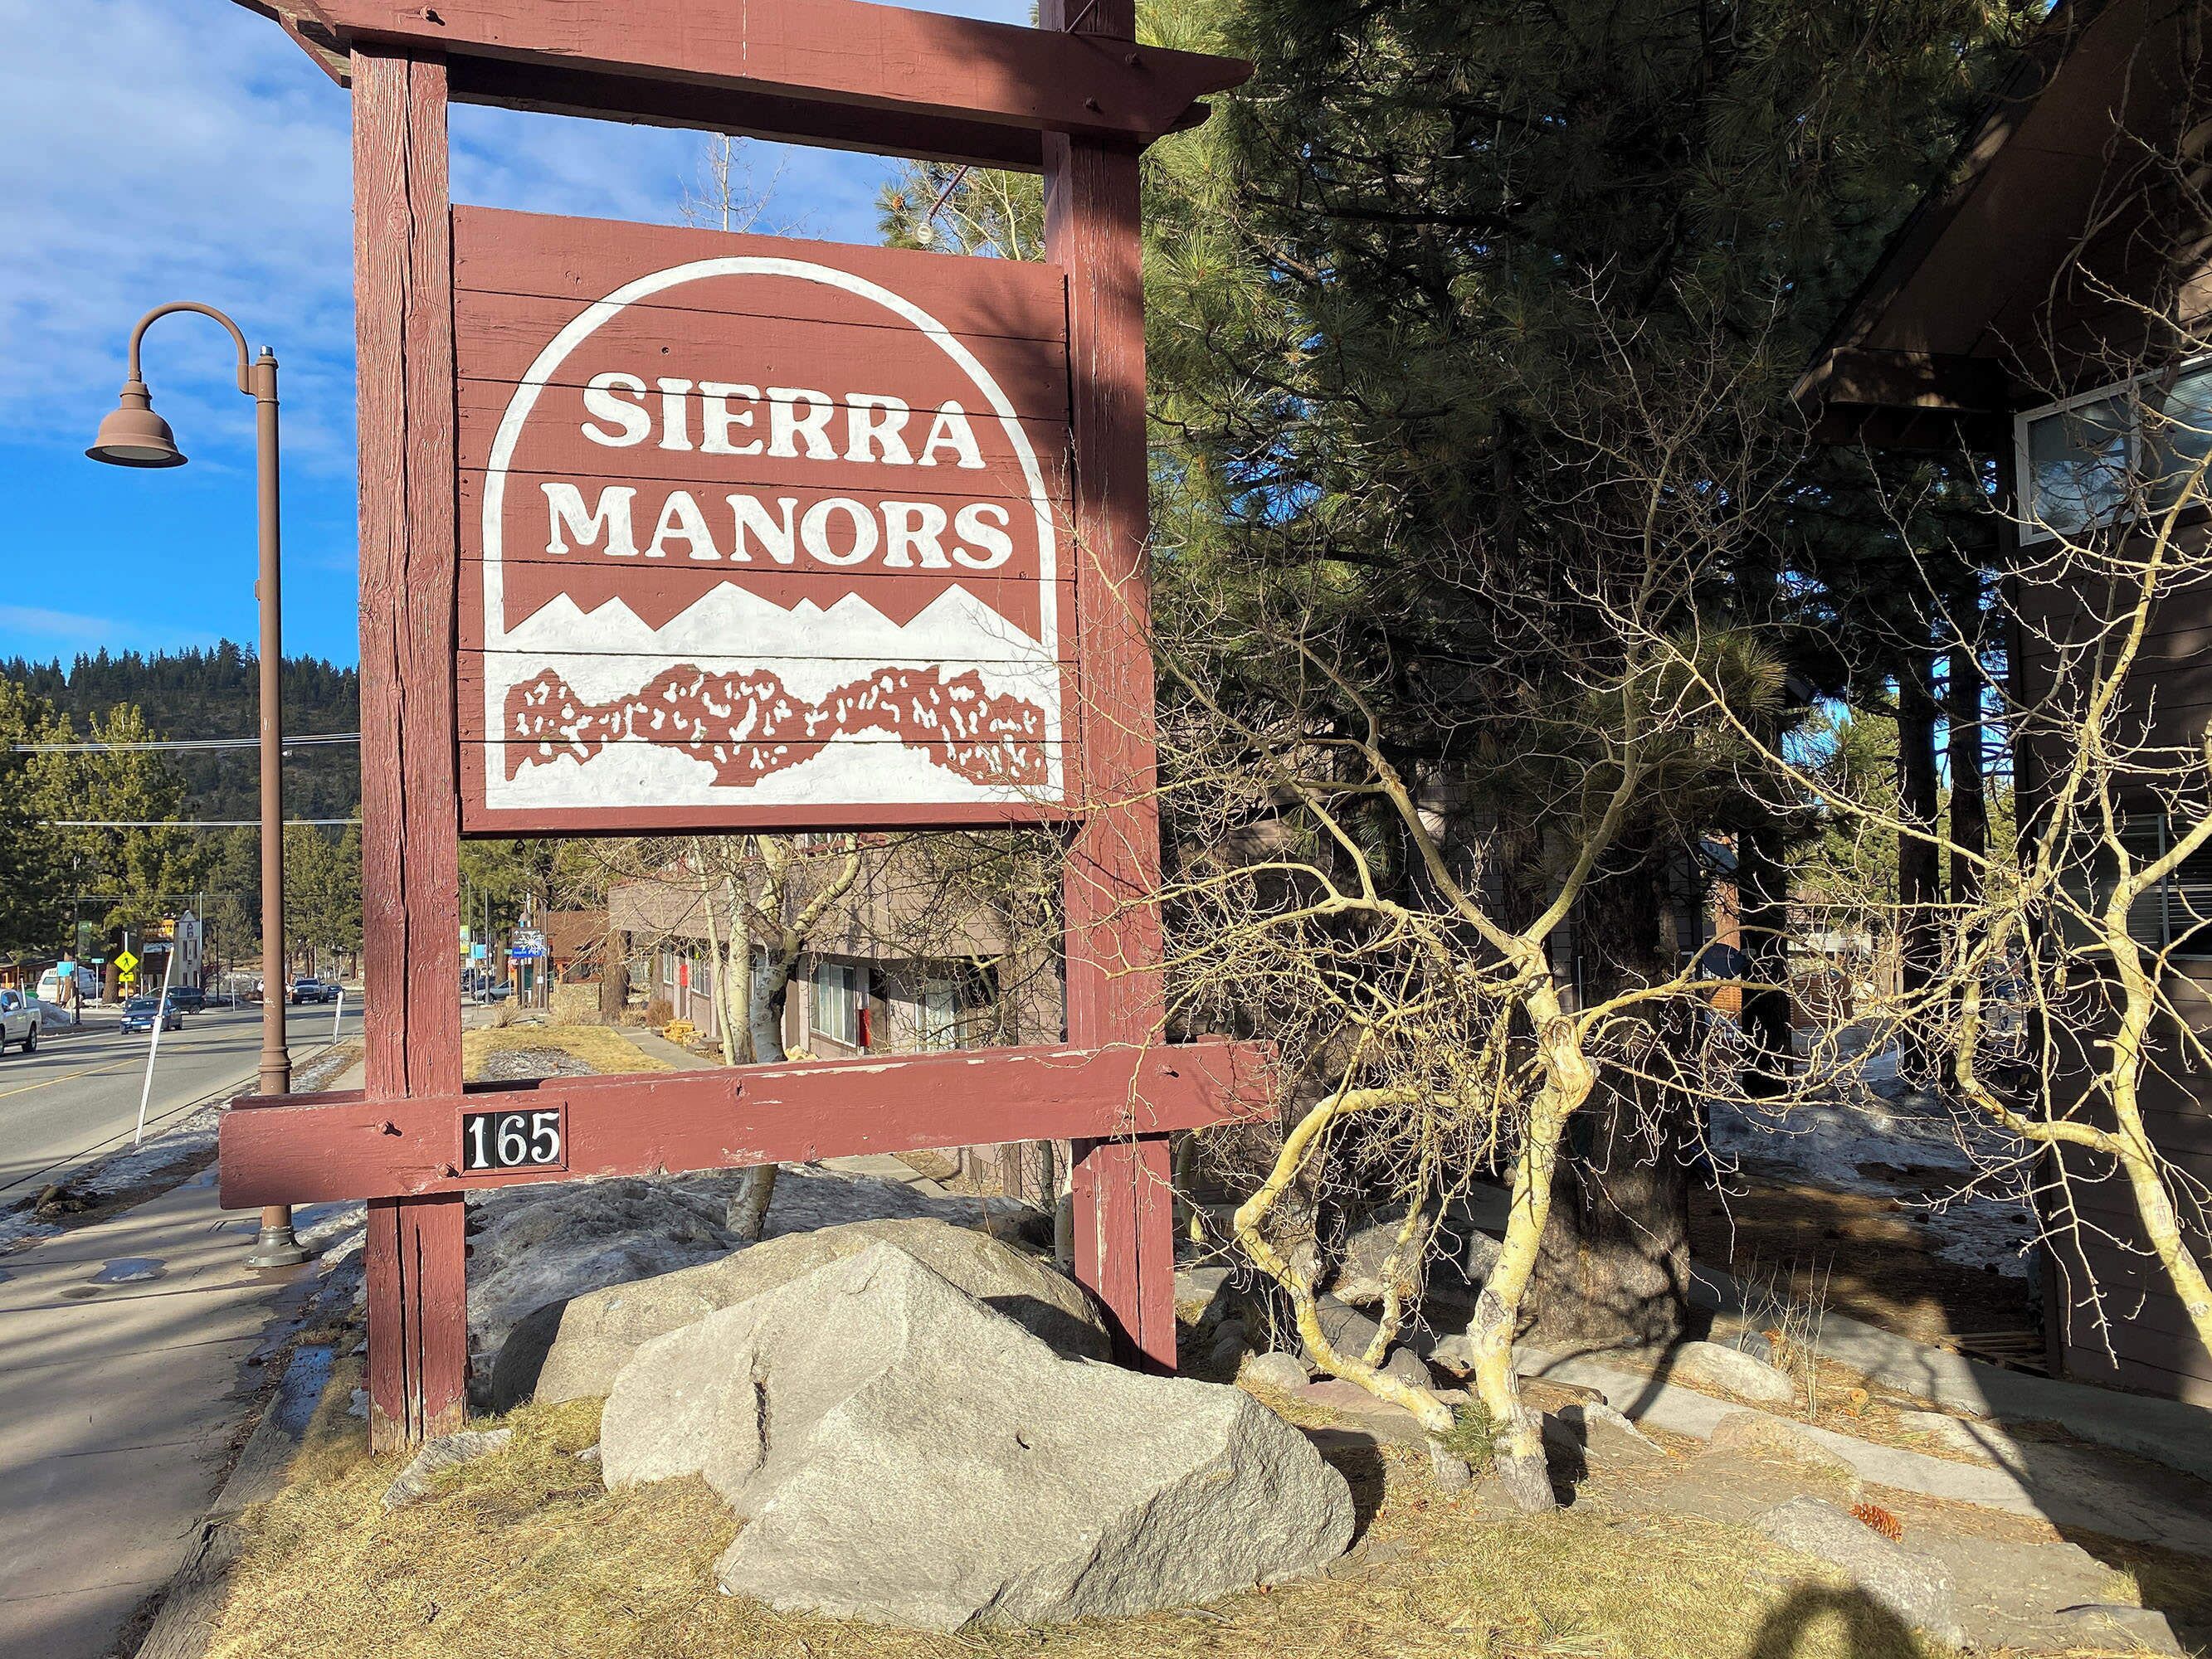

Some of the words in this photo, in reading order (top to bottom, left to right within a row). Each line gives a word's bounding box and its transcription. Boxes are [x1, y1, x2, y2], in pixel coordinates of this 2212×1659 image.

[581, 372, 986, 469] SIERRA
[540, 482, 1014, 570] MANORS
[467, 1112, 560, 1168] 165
